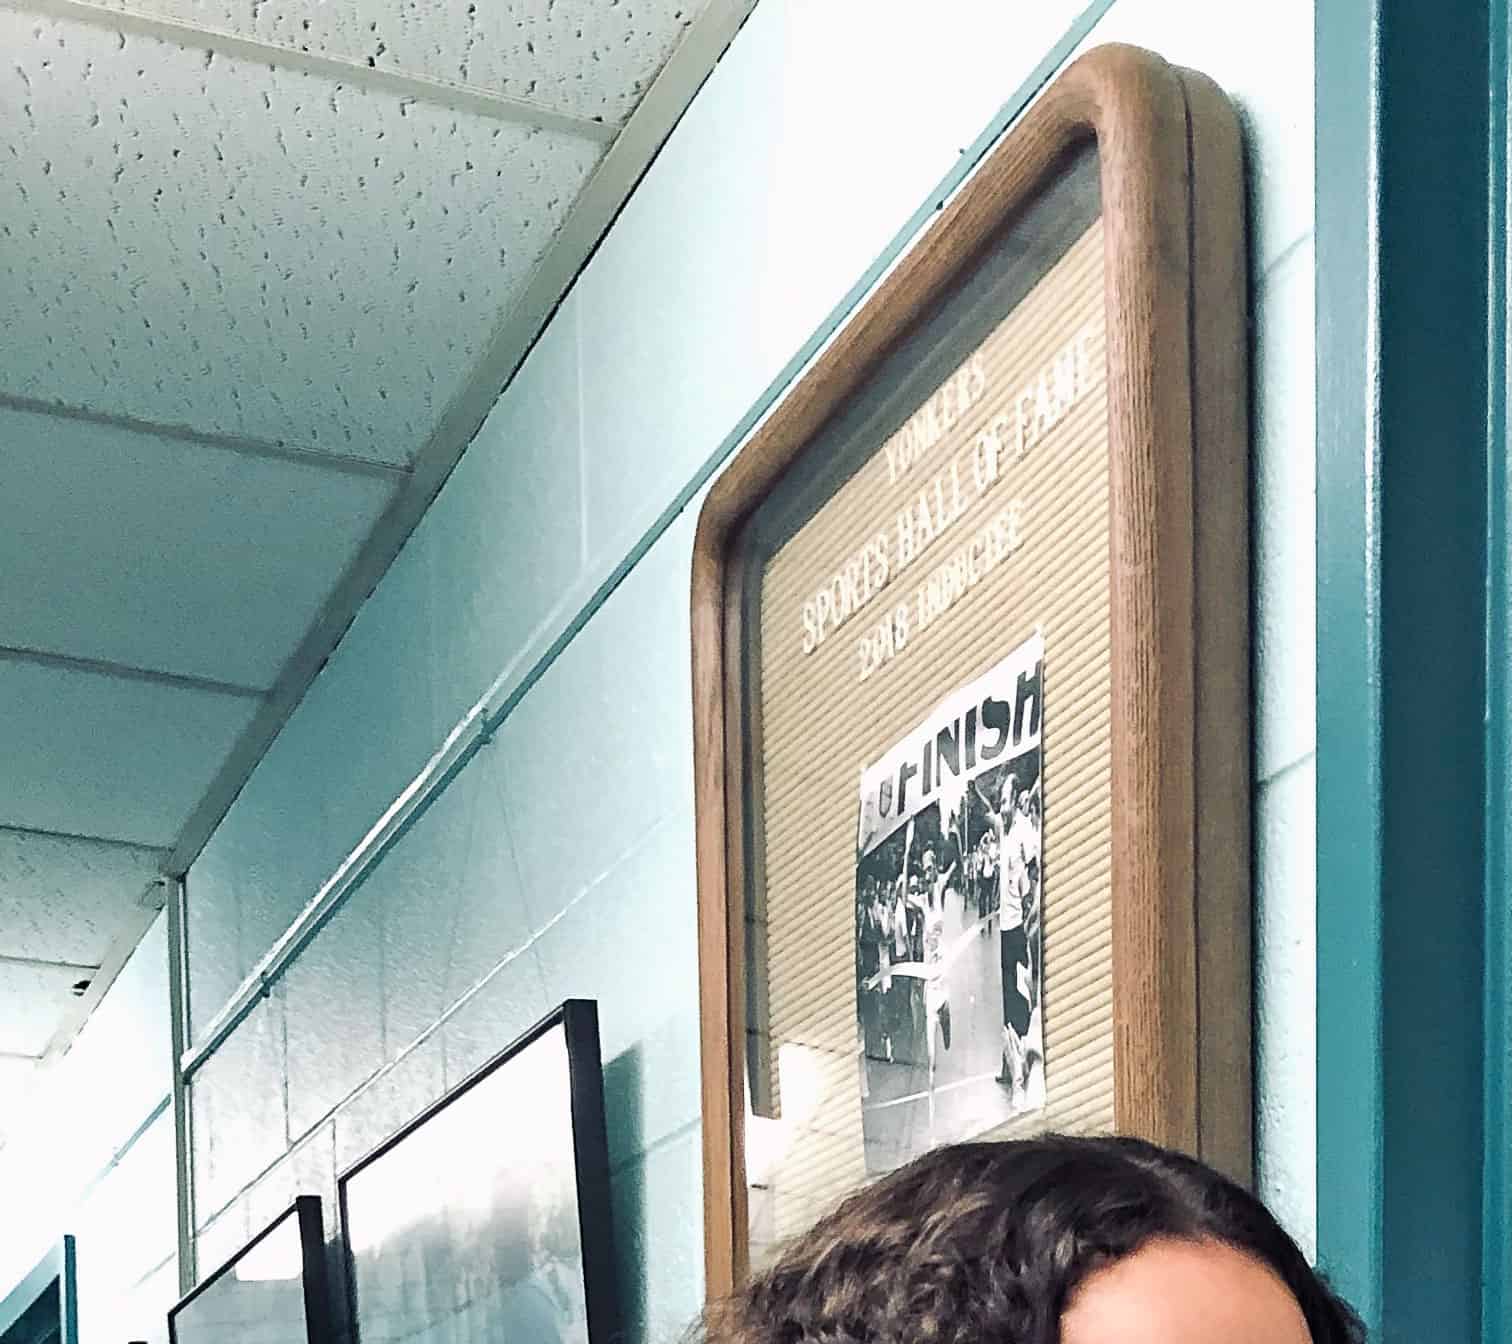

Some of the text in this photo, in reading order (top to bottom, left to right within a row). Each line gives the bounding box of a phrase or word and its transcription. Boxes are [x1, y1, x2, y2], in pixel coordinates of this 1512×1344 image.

[801, 332, 1096, 655] SPORTS HALL OF FAME
[883, 352, 986, 484] YONKERS
